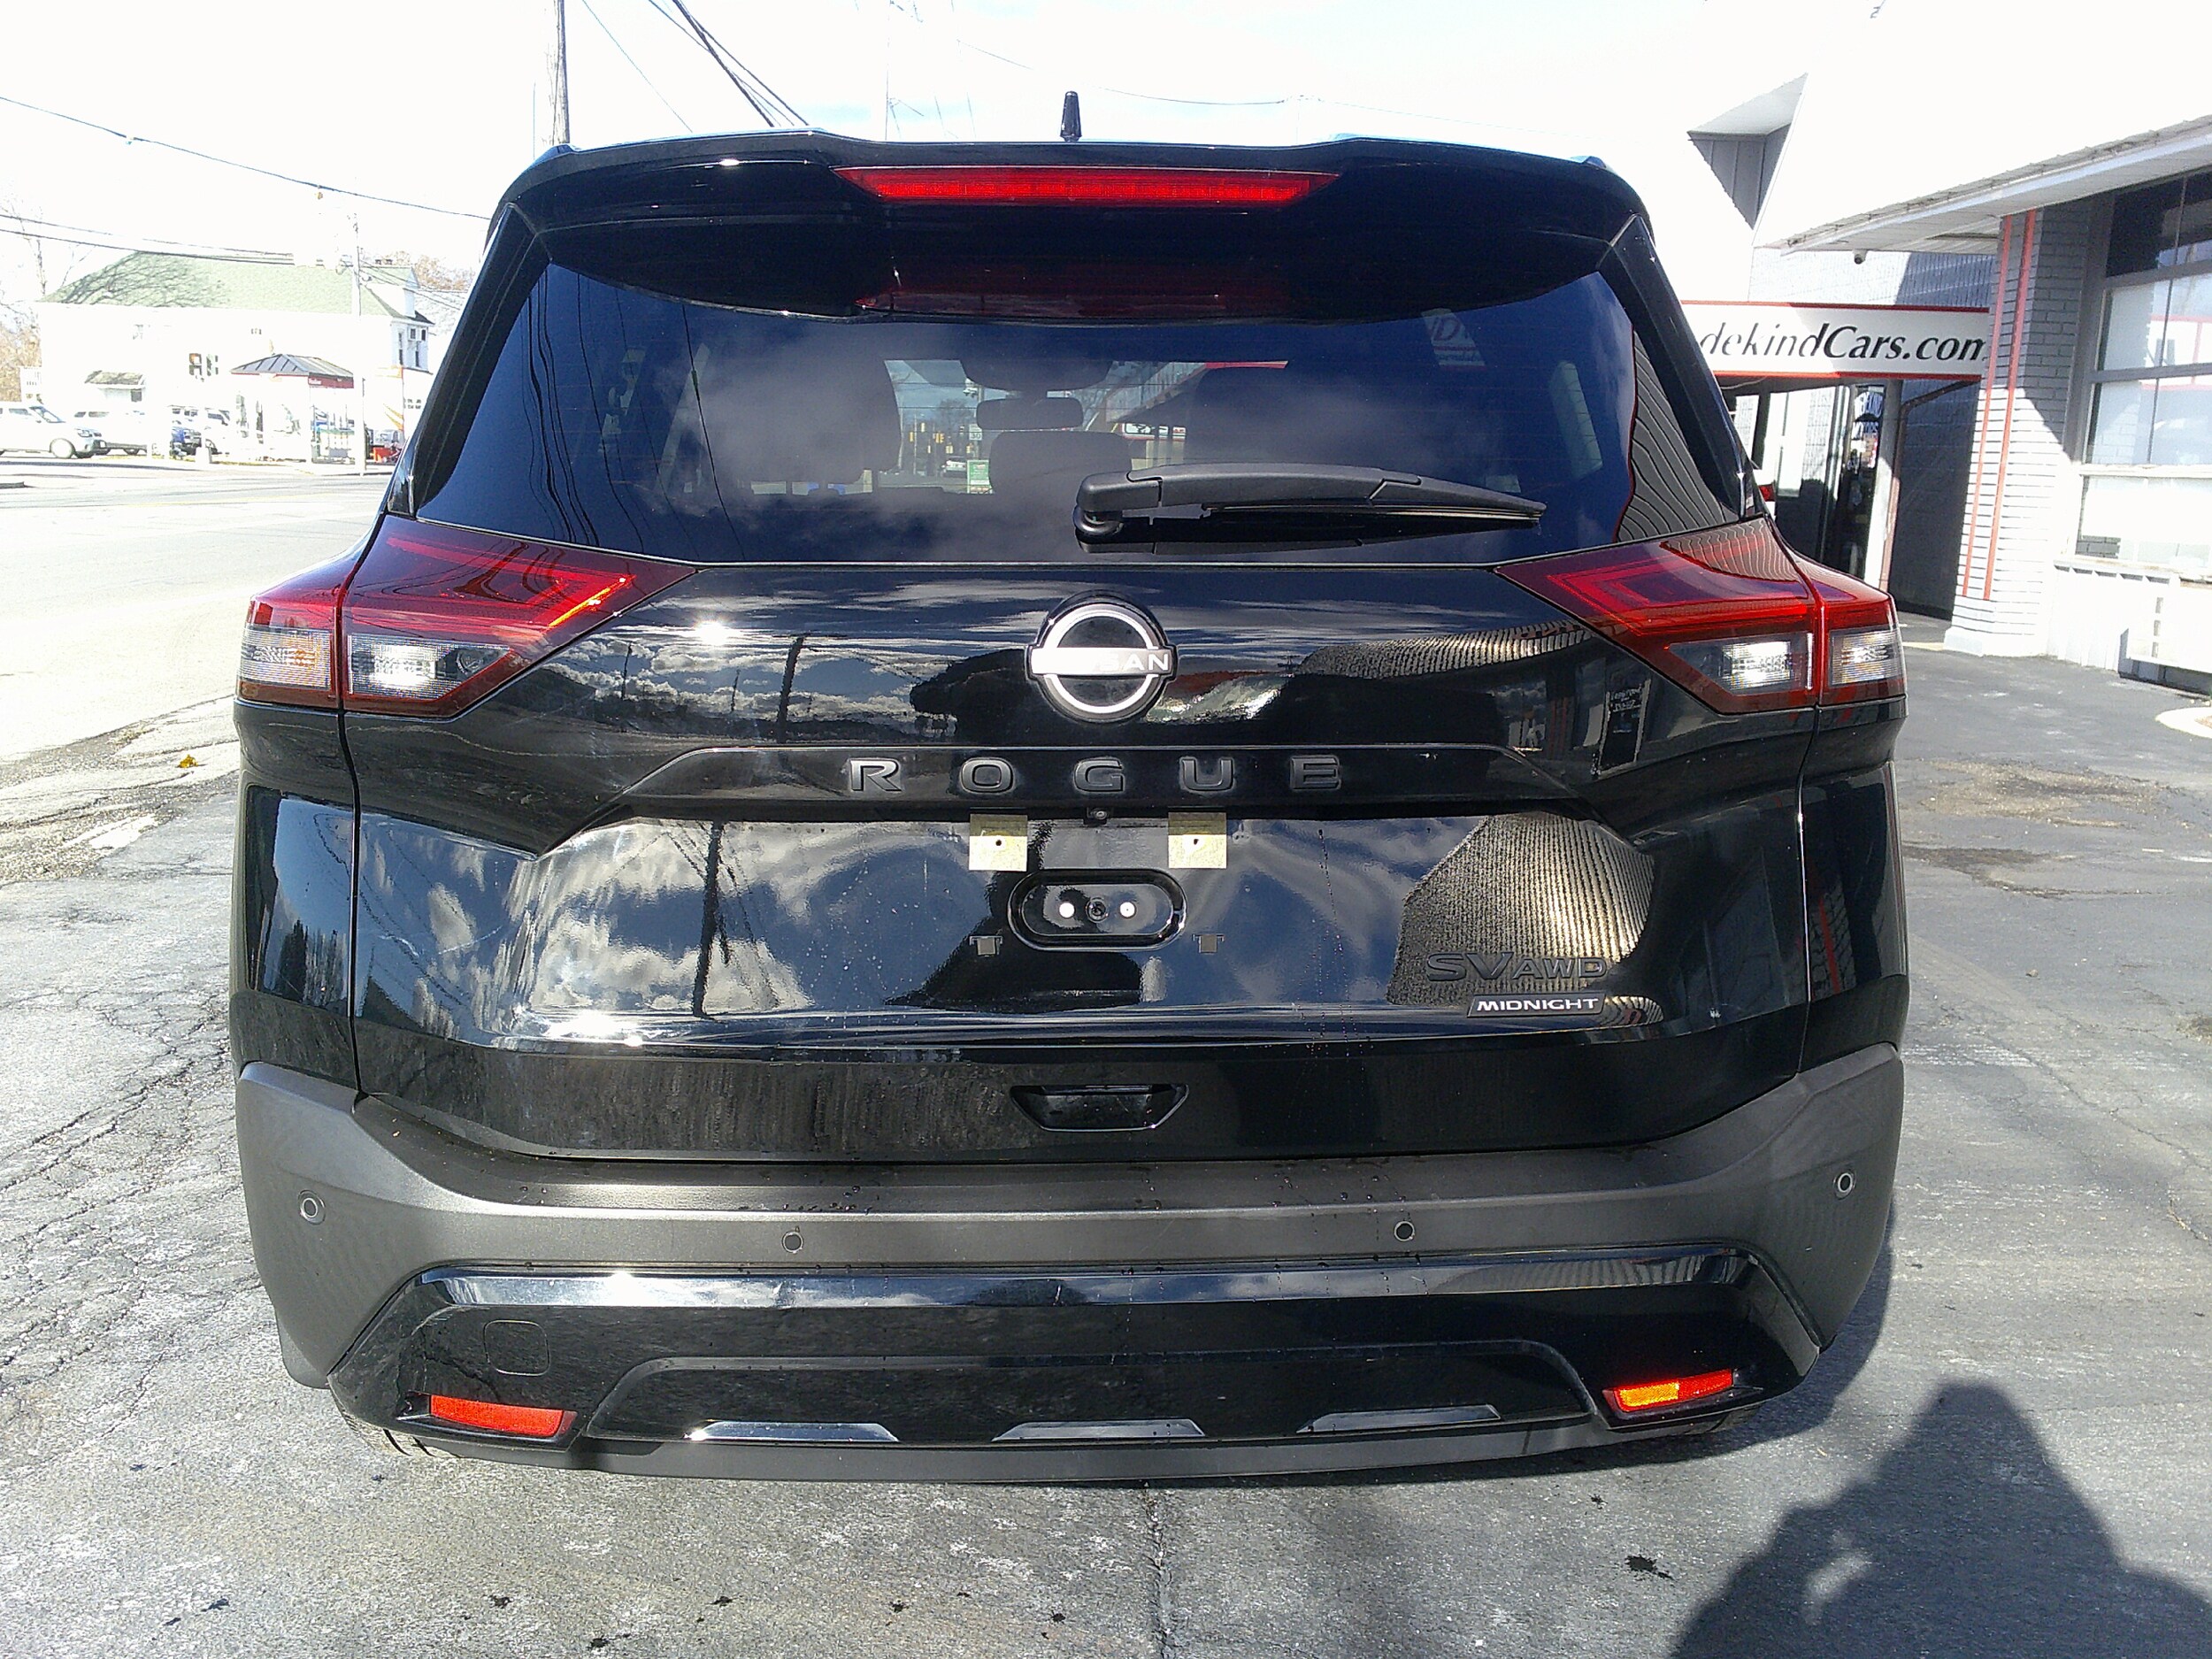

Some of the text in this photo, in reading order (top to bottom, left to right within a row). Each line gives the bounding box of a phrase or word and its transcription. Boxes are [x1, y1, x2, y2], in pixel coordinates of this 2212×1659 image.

[849, 757, 1341, 793] ROGUE
[1426, 952, 1608, 982] SV AWD
[1476, 997, 1599, 1012] MIDNIGHT
